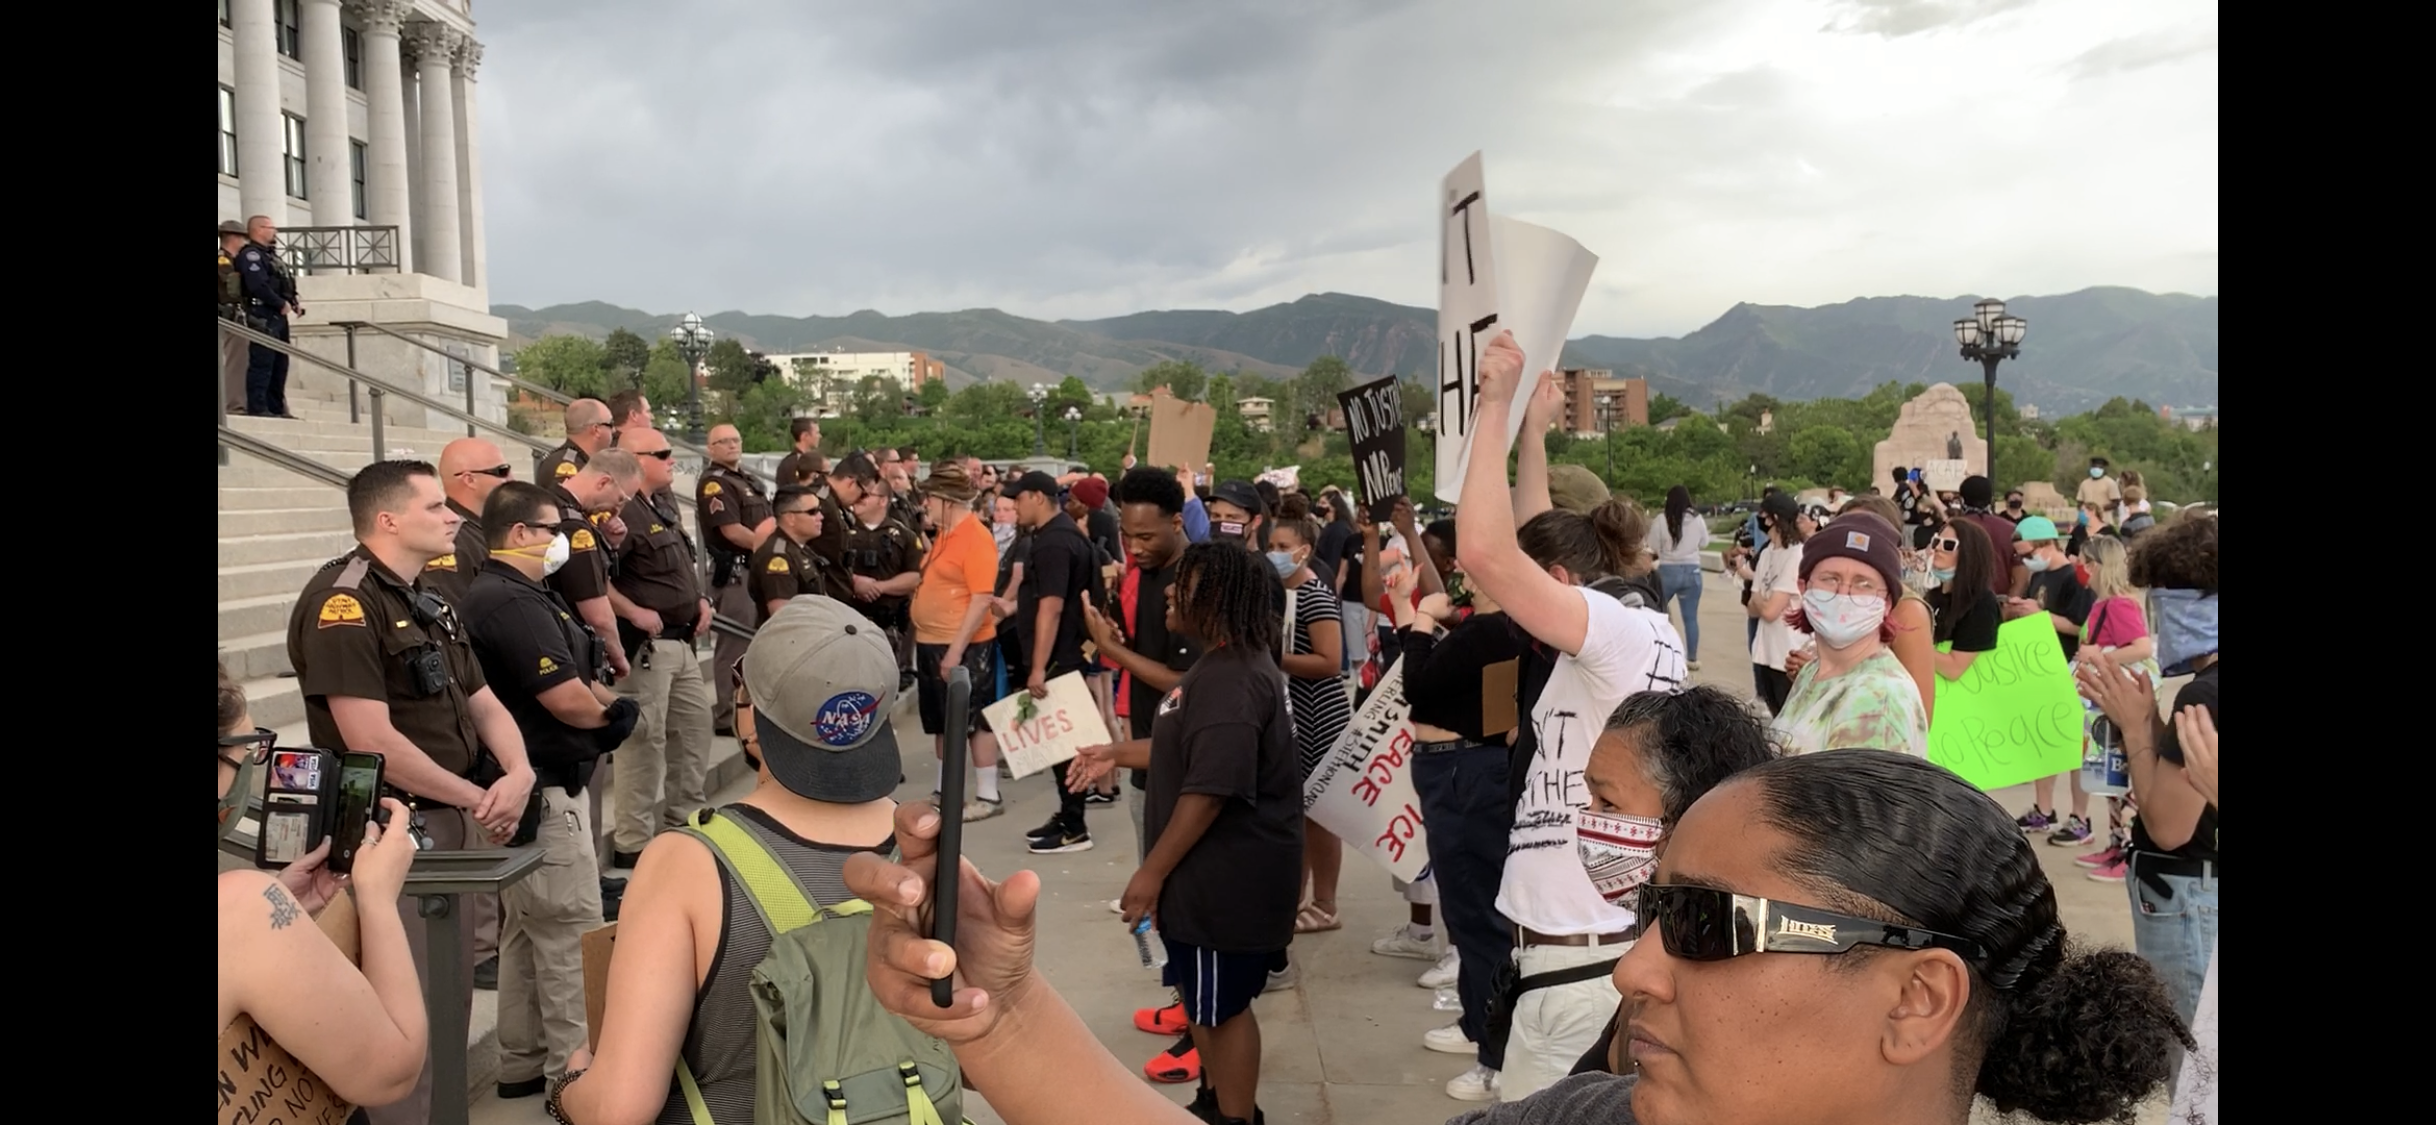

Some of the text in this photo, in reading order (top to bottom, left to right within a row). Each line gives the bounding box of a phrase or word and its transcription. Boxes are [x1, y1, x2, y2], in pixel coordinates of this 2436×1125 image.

[1348, 396, 1369, 444] NO
[821, 710, 870, 730] NASA
[1002, 709, 1074, 753] LIVES
[1960, 701, 2081, 774] Peace
[1351, 722, 1415, 808] EACE
[283, 1077, 314, 1118] NO
